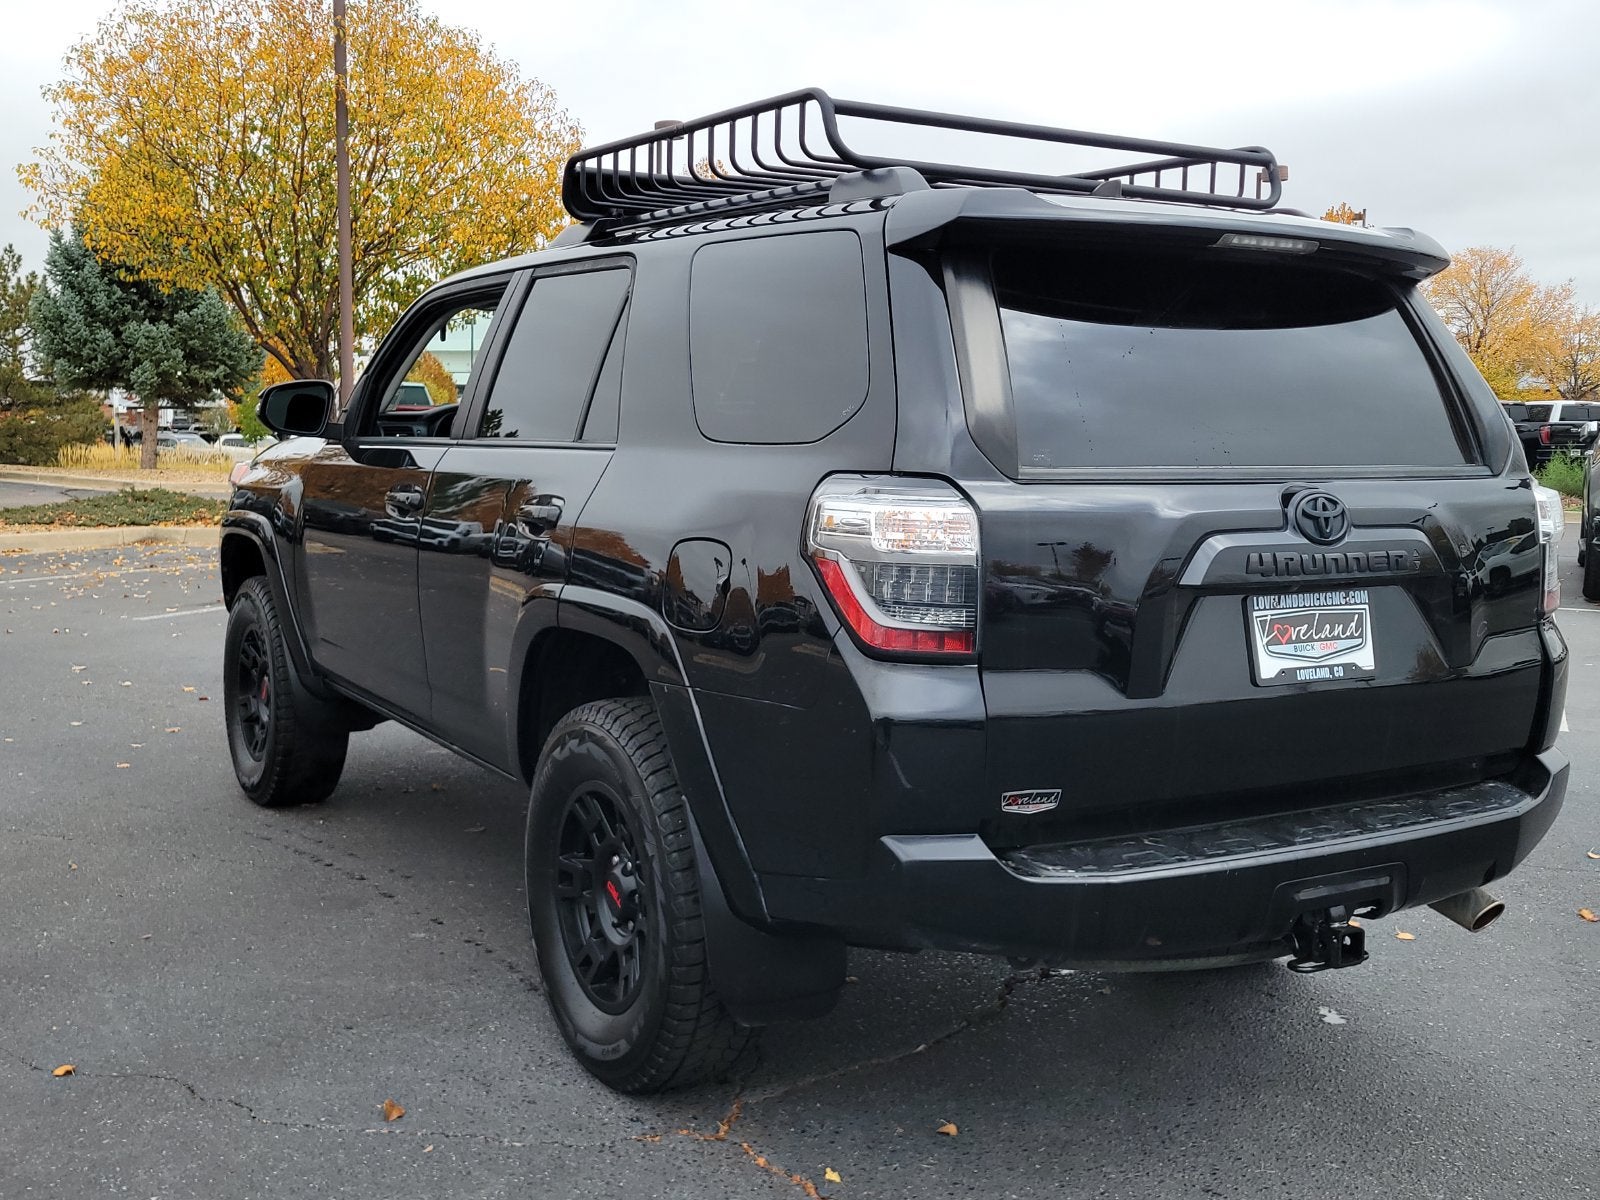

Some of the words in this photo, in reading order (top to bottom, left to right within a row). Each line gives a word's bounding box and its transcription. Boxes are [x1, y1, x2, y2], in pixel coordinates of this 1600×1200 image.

[1293, 643, 1316, 653] BUICK
[1319, 642, 1338, 651] GMC
[1296, 667, 1333, 681] LOVELAND,
[1333, 666, 1344, 677] CO
